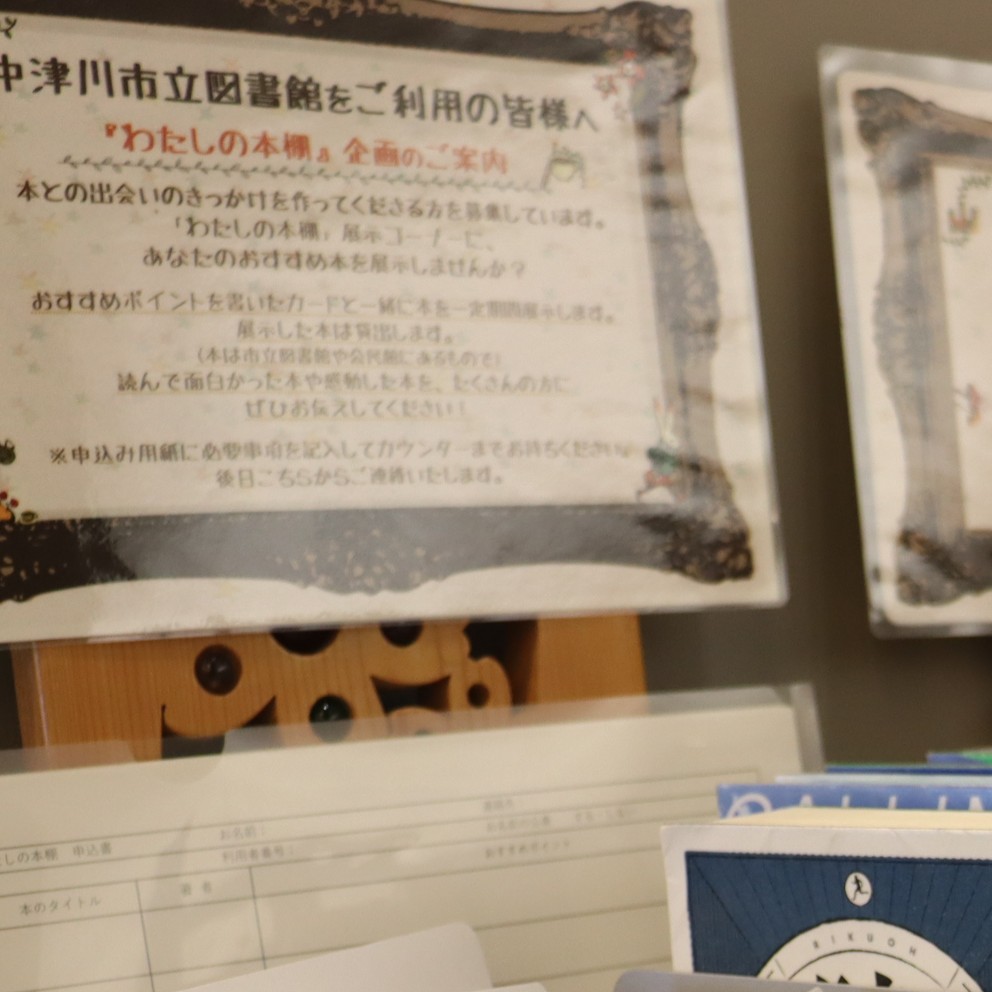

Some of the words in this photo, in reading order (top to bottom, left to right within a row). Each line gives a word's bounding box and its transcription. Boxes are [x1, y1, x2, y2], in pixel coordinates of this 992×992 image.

[0, 53, 599, 132] 中津川市立図書館をご利用の皆様へ
[813, 931, 918, 956] RIKUOH
